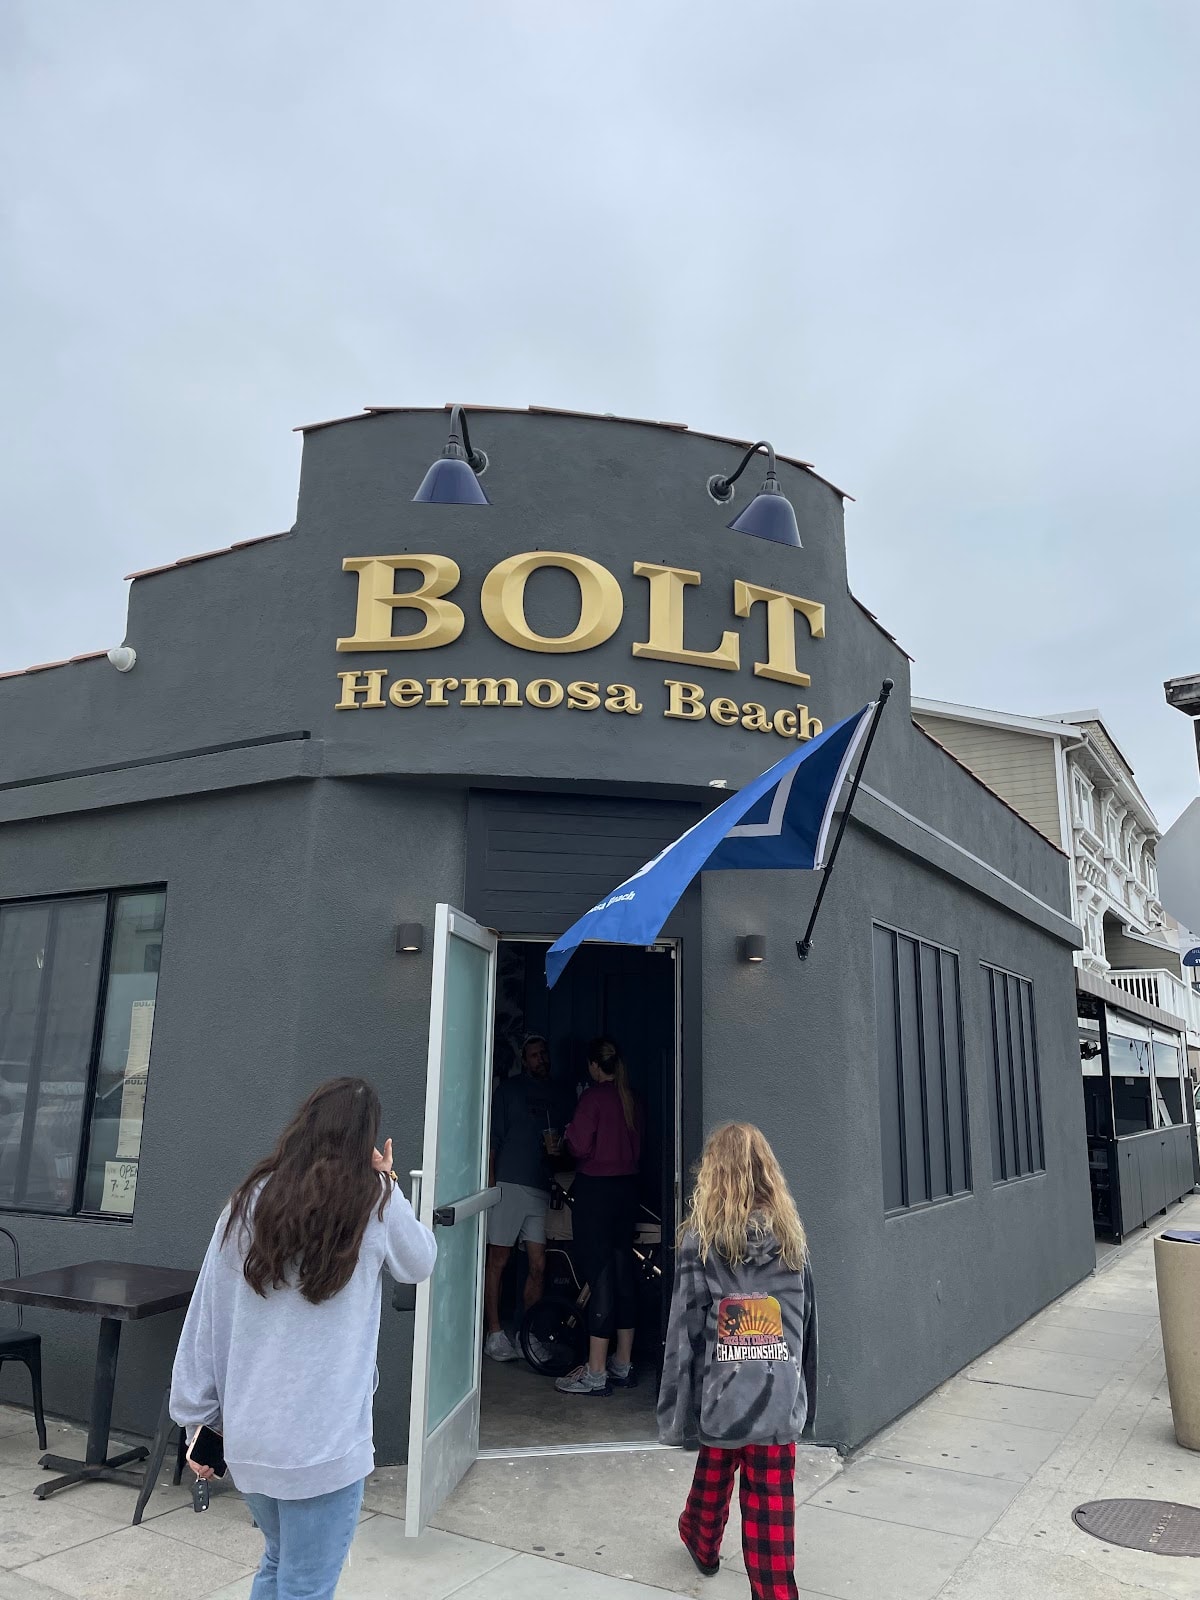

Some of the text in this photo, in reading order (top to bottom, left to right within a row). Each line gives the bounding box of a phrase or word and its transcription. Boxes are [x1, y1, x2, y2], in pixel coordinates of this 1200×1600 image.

[336, 551, 826, 687] BOLT
[335, 669, 824, 741] Hermosa Beach
[717, 1341, 789, 1361] CHAMPIONSHIPS
